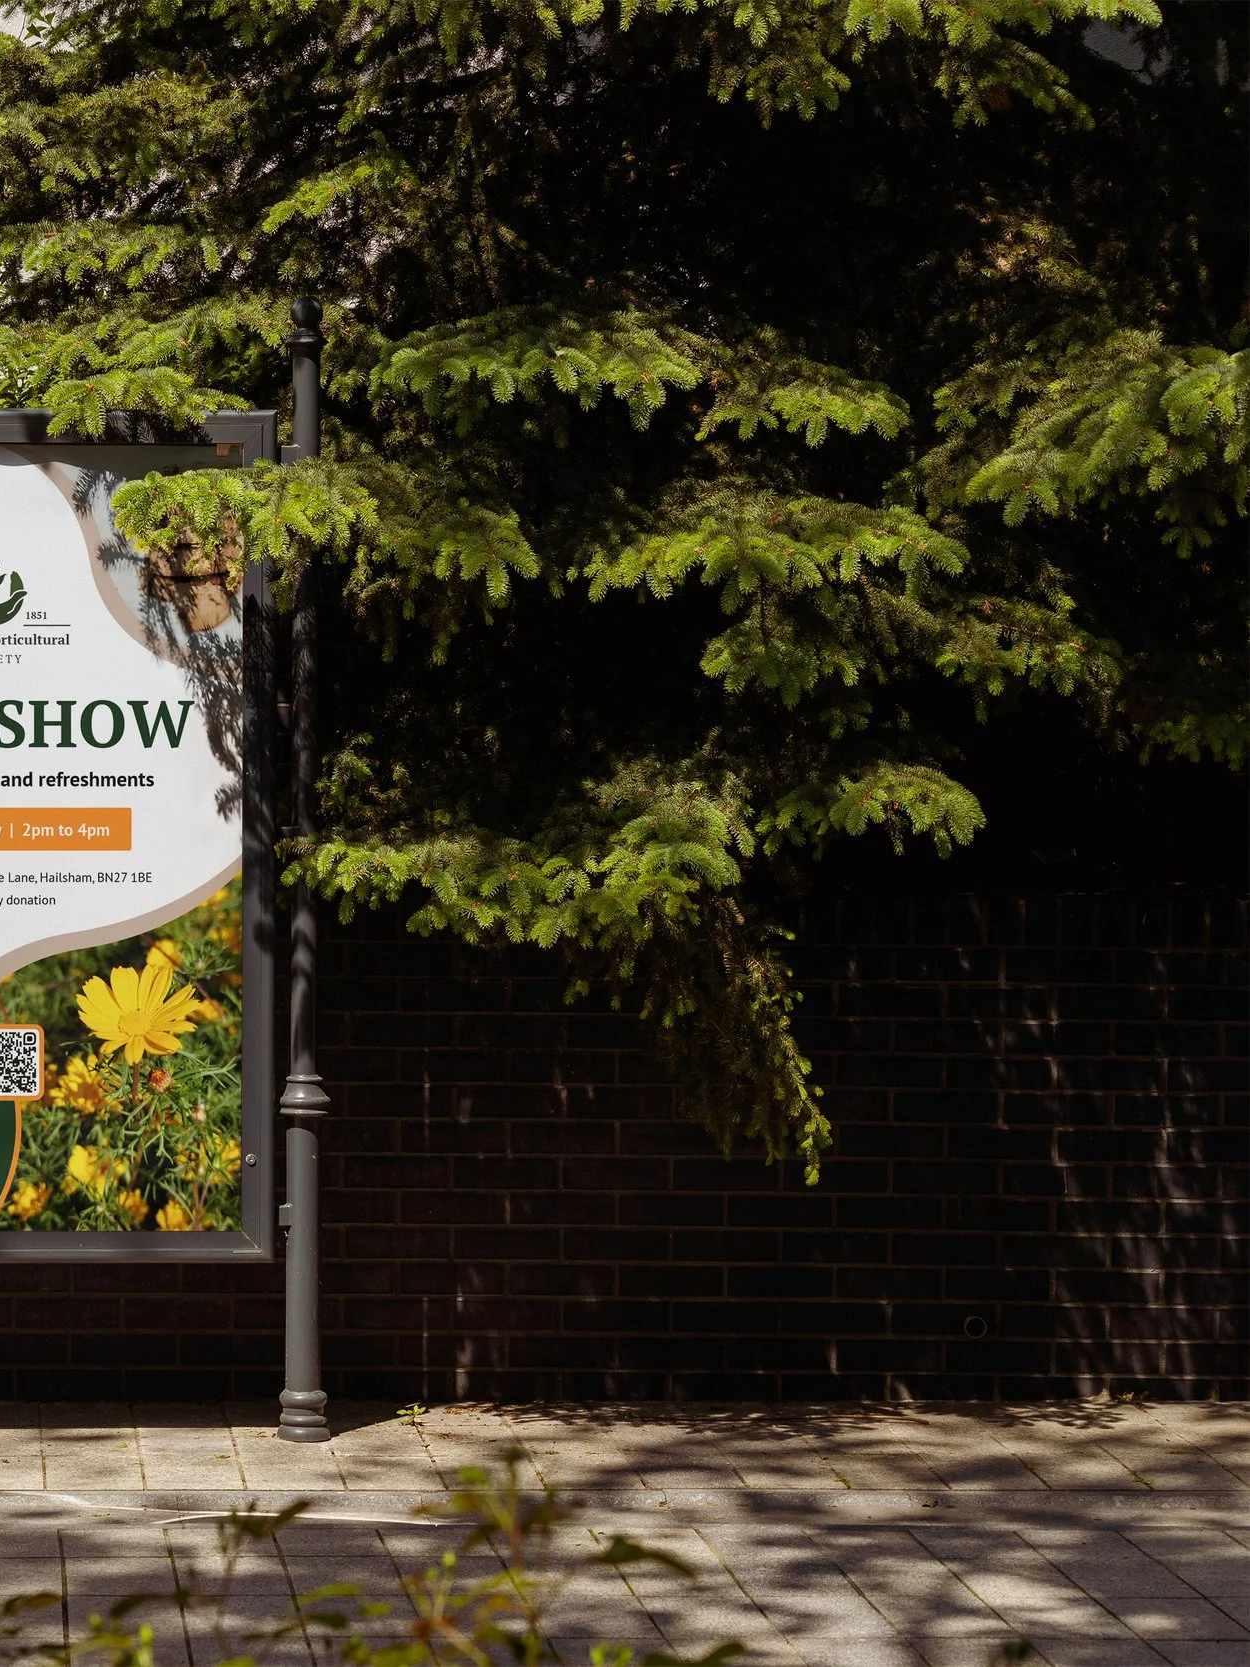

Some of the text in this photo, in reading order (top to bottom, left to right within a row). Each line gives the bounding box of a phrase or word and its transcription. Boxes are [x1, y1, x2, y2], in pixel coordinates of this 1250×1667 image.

[27, 611, 47, 620] 1851
[1, 771, 32, 788] and
[39, 771, 154, 788] refreshments
[23, 822, 54, 841] 2pm
[58, 824, 73, 837] to
[78, 822, 109, 840] 4pm
[9, 871, 37, 885] Lane,
[40, 871, 95, 885] Hailsham,
[98, 871, 127, 883] BN27
[132, 871, 152, 883] 1BE
[7, 894, 55, 906] donation
